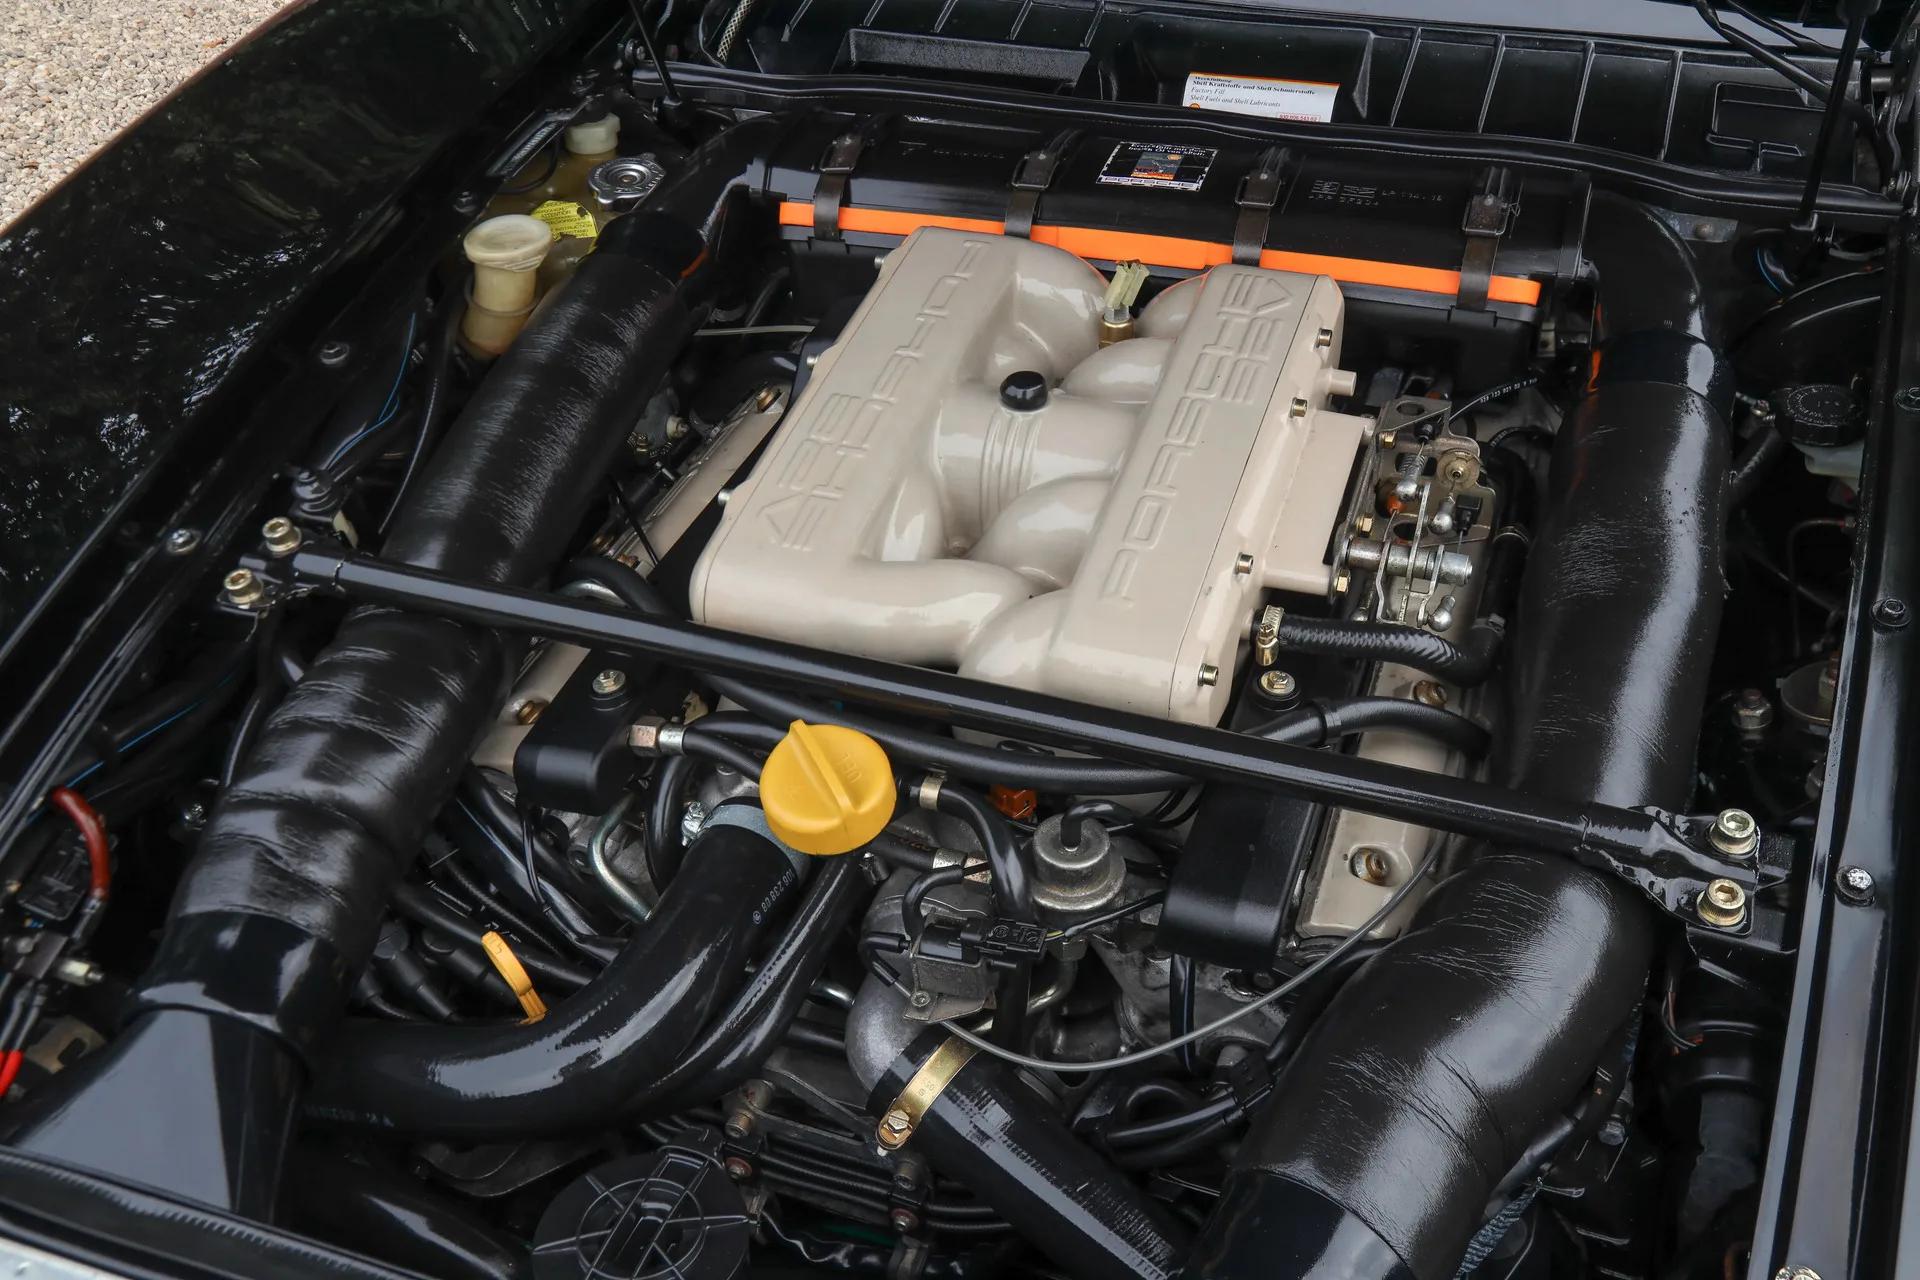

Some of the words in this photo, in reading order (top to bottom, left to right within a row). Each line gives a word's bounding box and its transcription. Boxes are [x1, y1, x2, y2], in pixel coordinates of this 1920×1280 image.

[1191, 87, 1213, 95] Factory
[1234, 97, 1249, 105] Shell
[1104, 177, 1194, 188] PORSCHE
[781, 239, 992, 552] PORSCHE
[1102, 272, 1263, 607] PORSCHE
[770, 881, 784, 901] 238
